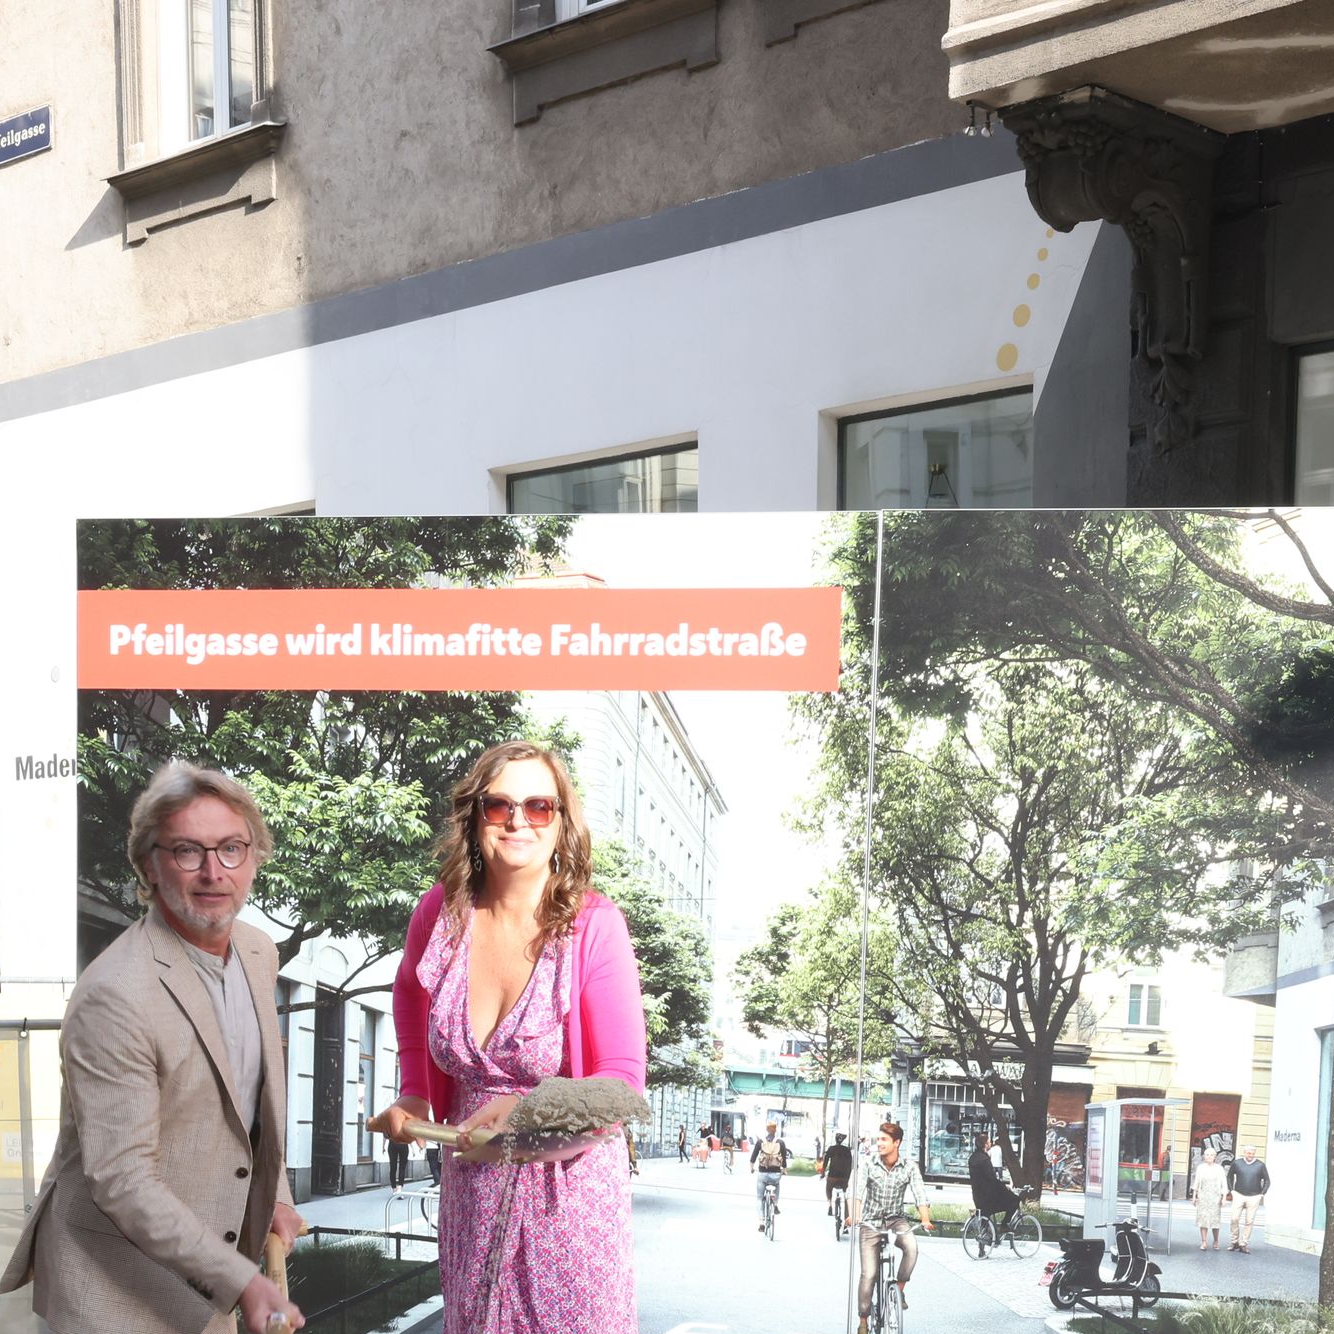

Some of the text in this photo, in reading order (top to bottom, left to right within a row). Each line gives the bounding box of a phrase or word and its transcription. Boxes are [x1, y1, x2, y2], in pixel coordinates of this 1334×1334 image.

[109, 622, 808, 665] Pfeilgasse wird klimafitte Fahrradstraße
